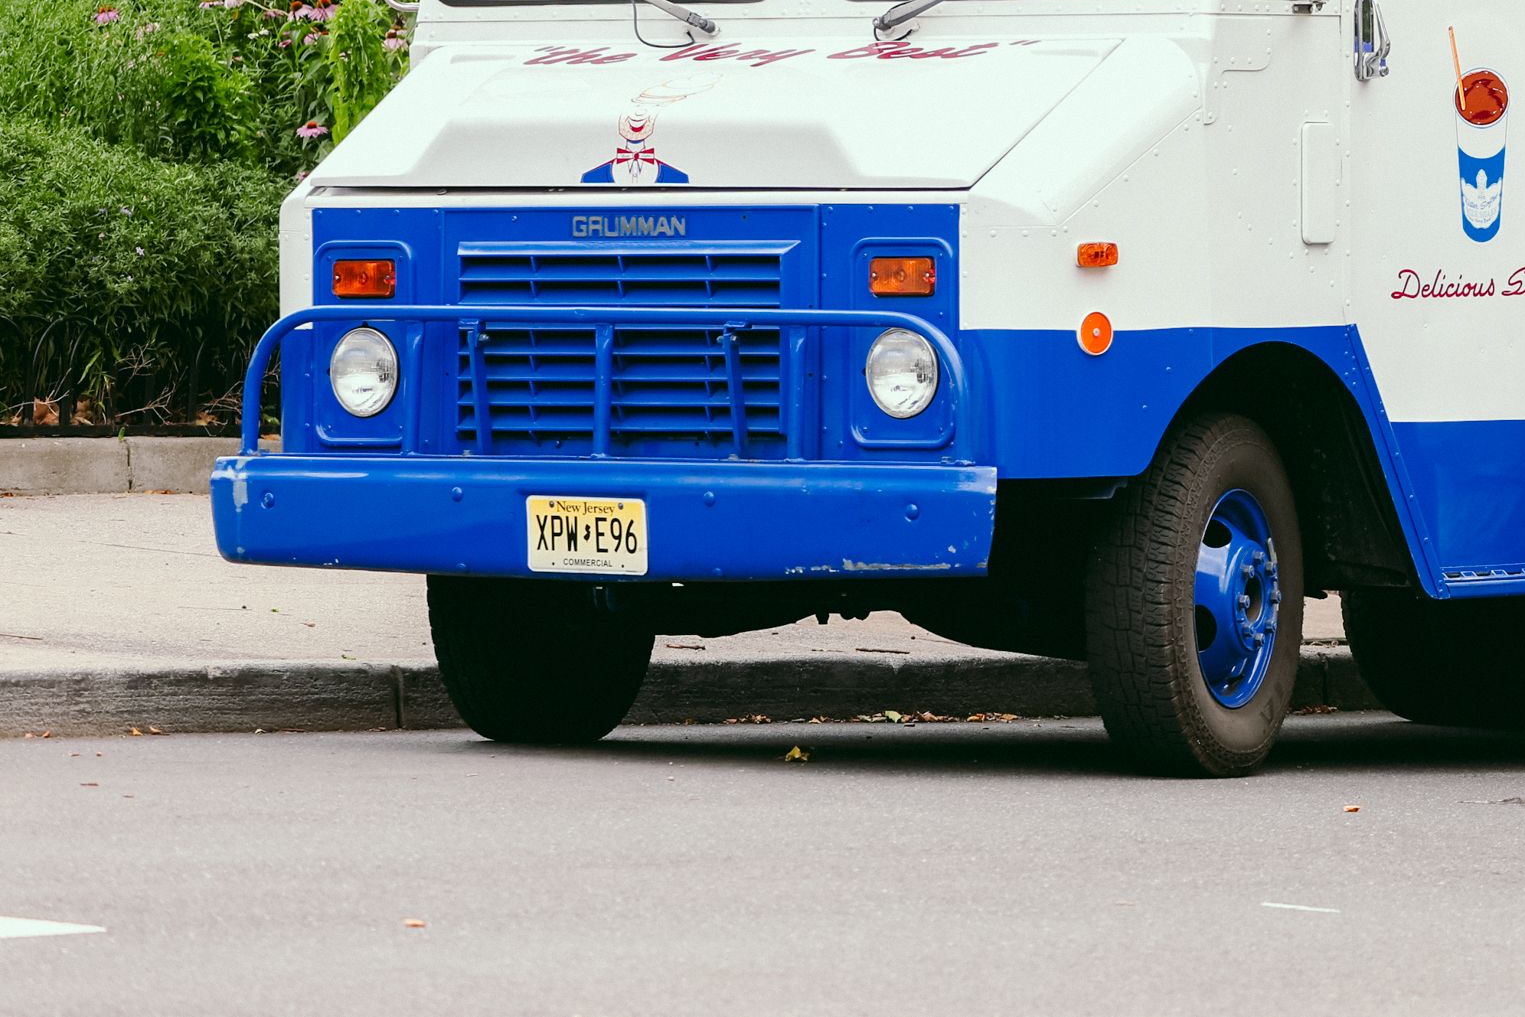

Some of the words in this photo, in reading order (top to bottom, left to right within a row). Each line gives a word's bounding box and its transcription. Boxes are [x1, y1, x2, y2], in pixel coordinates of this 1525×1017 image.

[660, 42, 815, 67] Very
[572, 215, 686, 238] GRUMMAN
[1391, 268, 1495, 299] Delicious
[556, 500, 582, 513] New
[583, 501, 615, 516] Jersey
[536, 514, 578, 552] XPW
[595, 517, 638, 554] E96
[563, 558, 613, 568] COMMERCIAL
